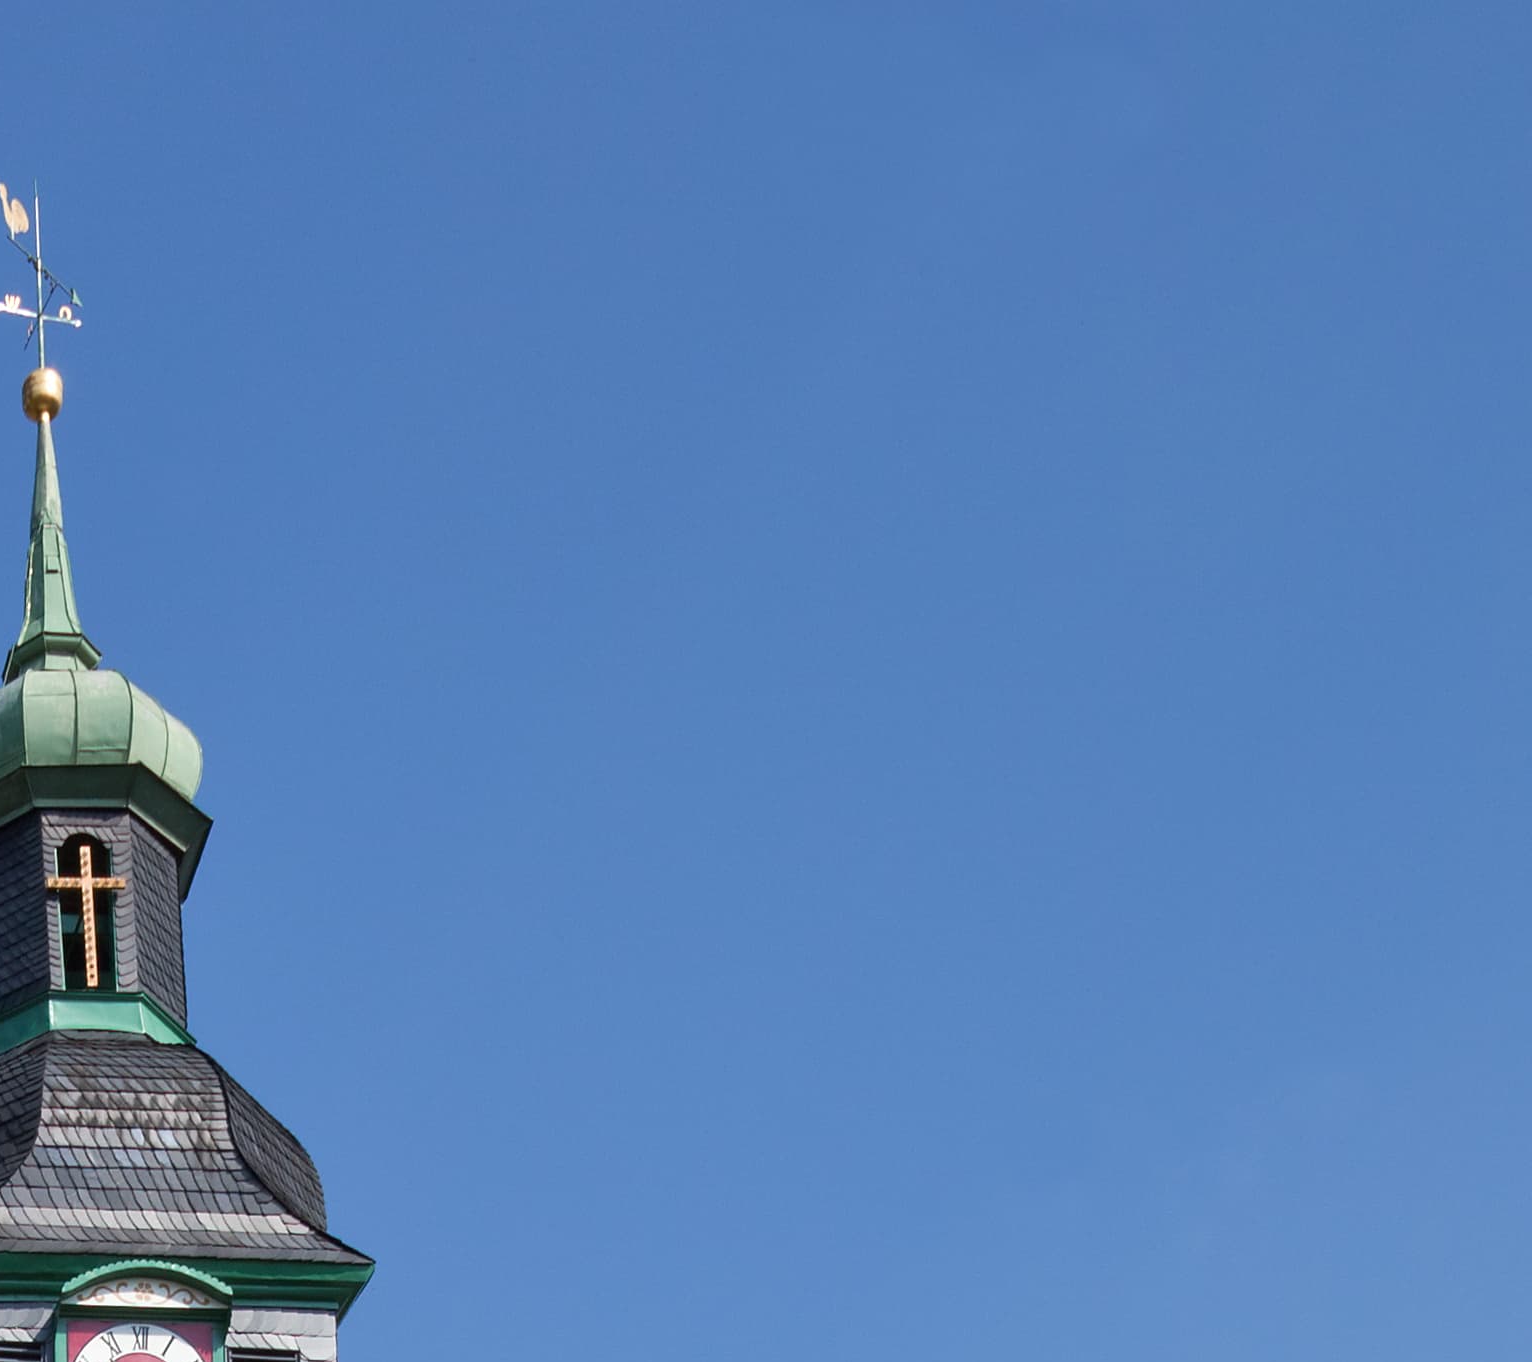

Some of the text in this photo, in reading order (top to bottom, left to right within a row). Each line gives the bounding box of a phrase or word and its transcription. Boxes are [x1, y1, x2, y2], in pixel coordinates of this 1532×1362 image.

[100, 1331, 122, 1359] XI
[132, 1326, 149, 1351] XII
[161, 1335, 175, 1356] I
